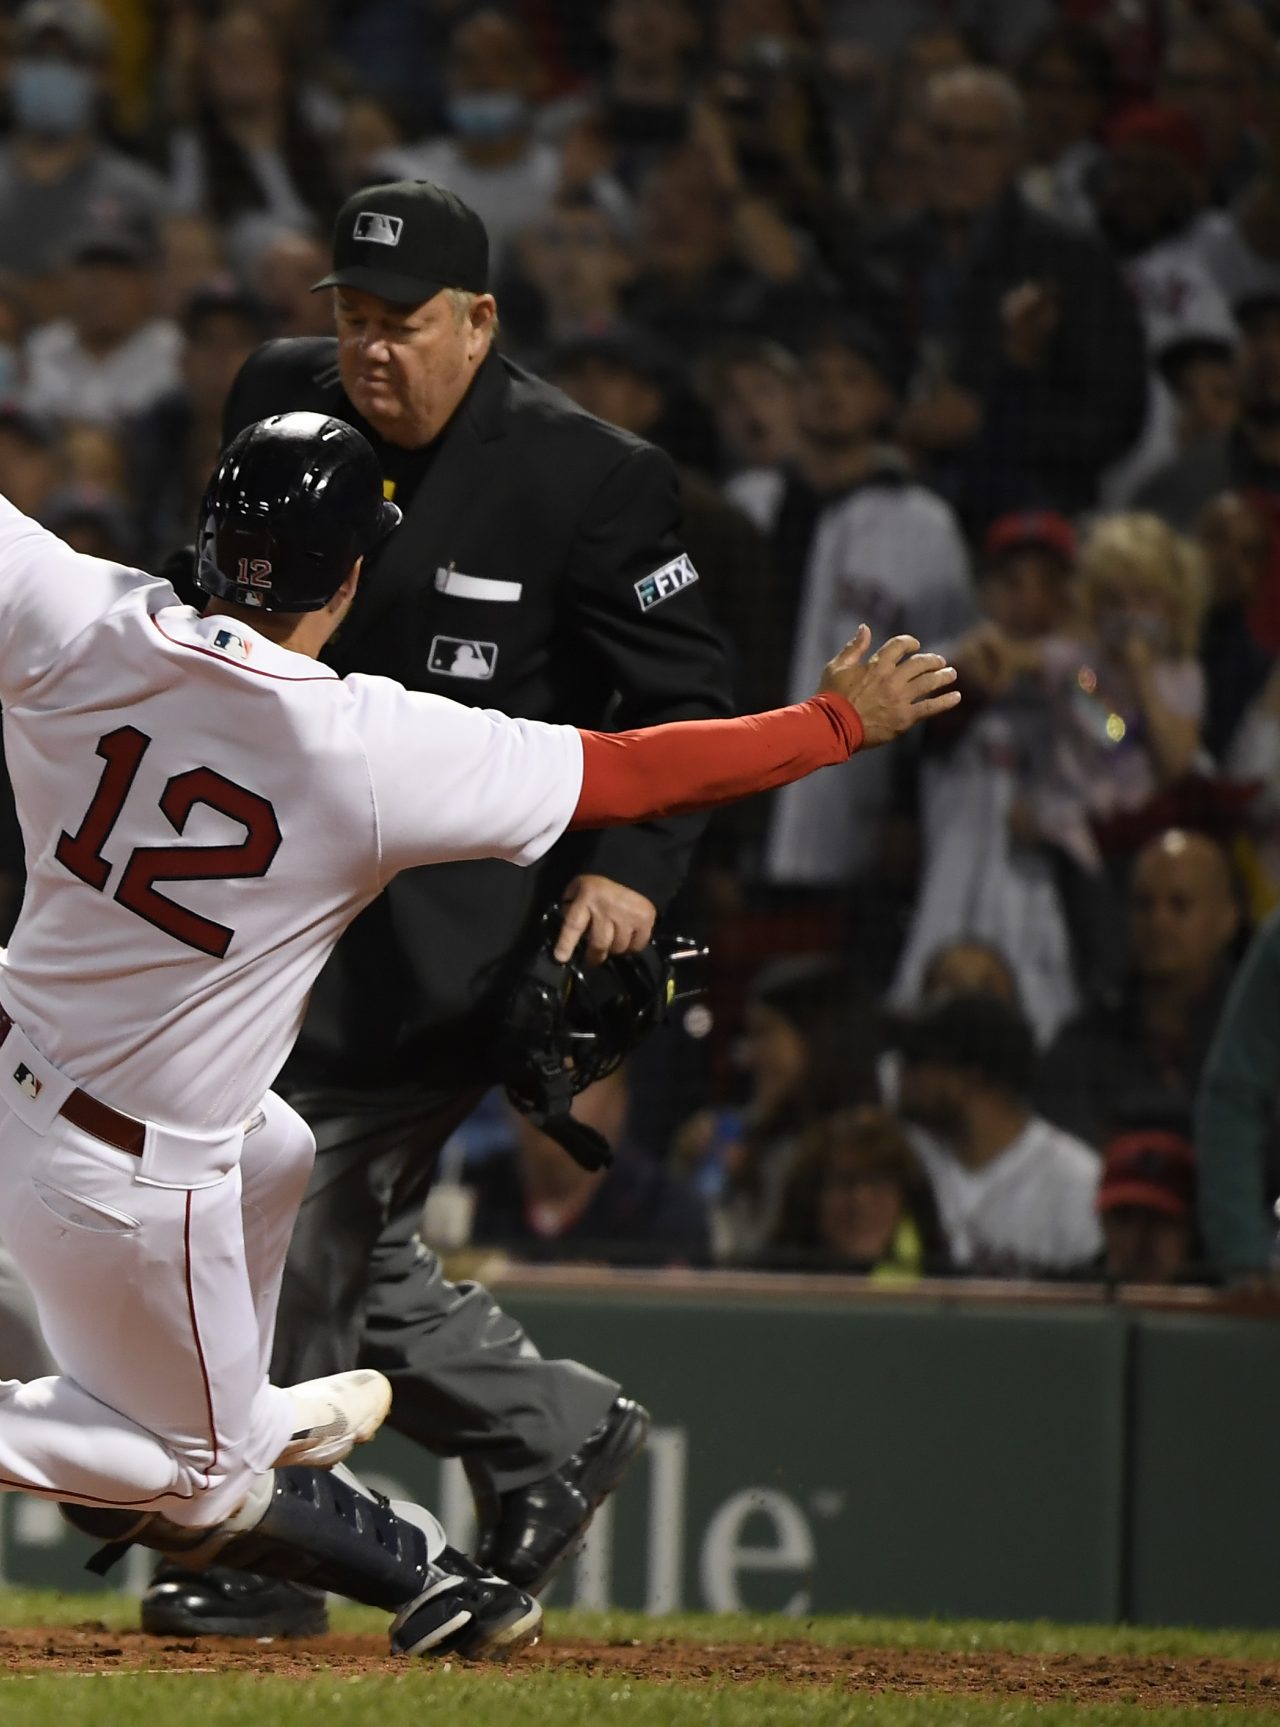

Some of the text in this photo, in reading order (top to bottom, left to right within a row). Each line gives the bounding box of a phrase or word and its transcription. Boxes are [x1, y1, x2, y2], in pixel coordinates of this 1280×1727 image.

[237, 557, 272, 589] 12
[654, 558, 695, 598] FTX
[54, 724, 283, 960] 12
